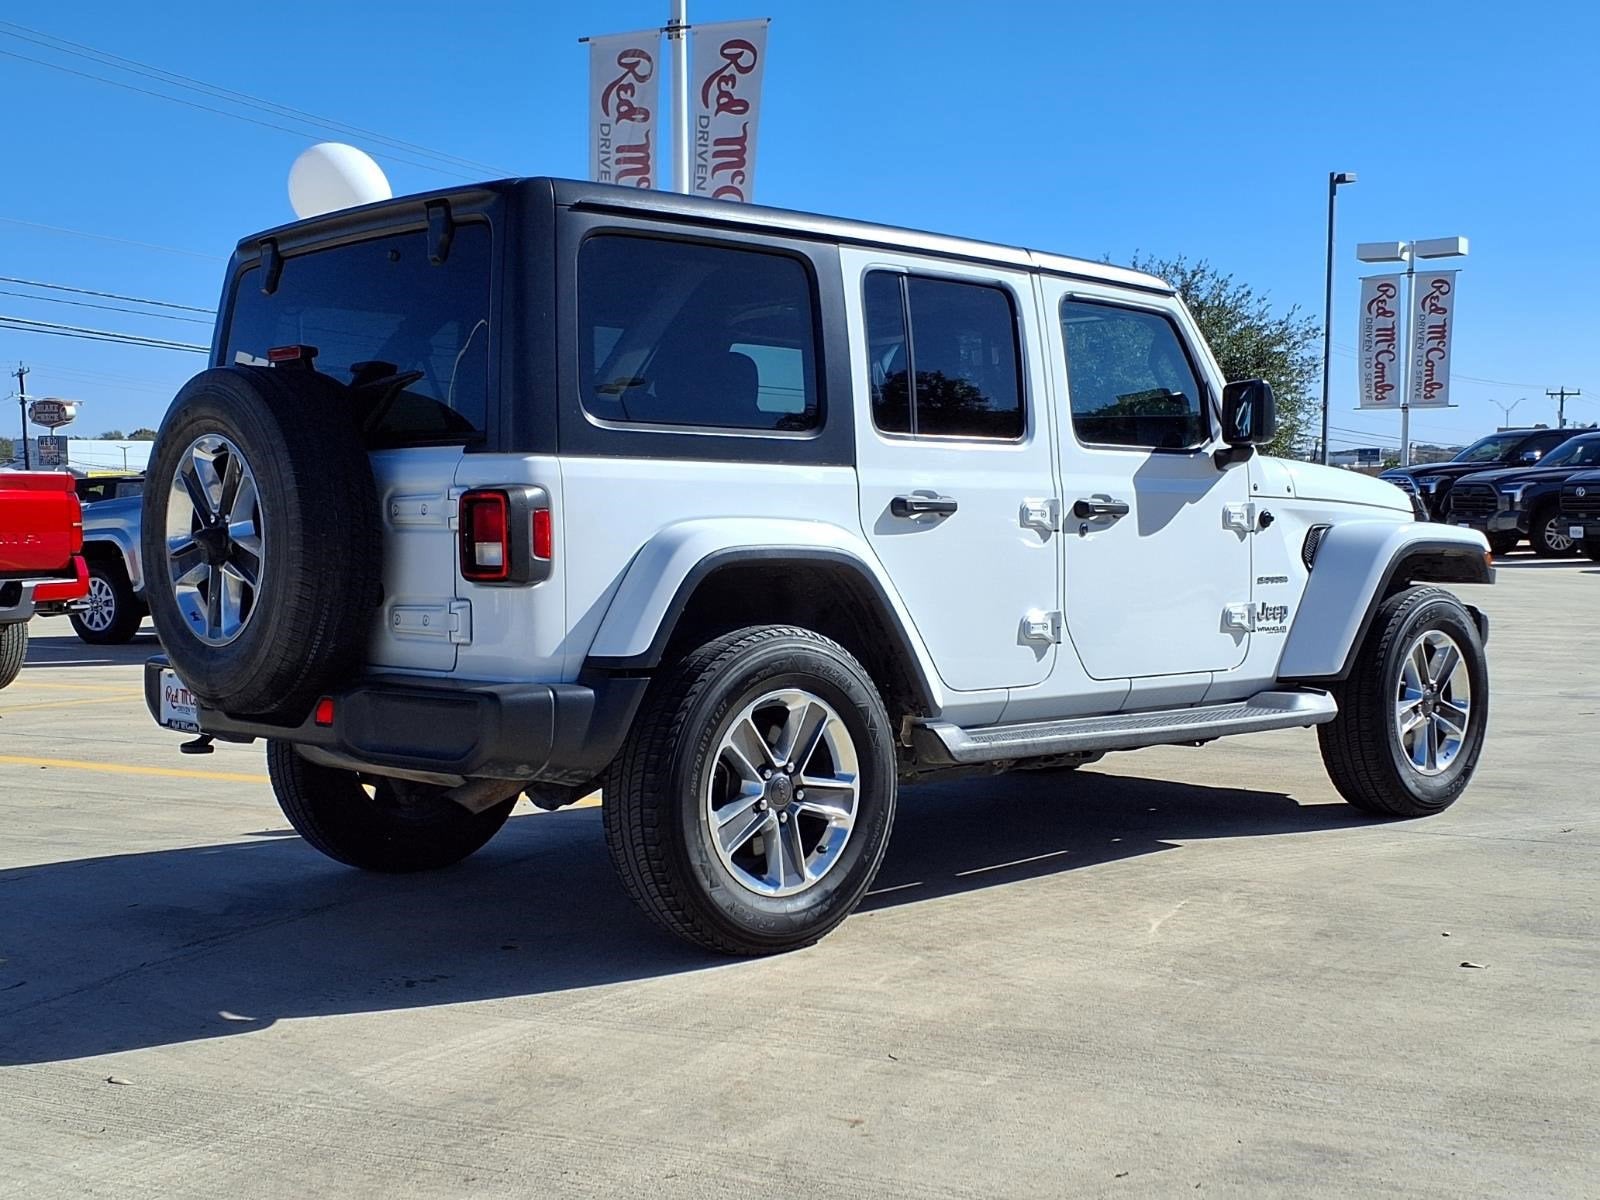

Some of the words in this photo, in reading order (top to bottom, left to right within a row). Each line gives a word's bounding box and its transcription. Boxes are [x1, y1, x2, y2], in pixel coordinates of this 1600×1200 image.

[601, 48, 653, 125] Red
[702, 39, 757, 117] Red
[696, 115, 710, 190] DRIVEN
[1367, 283, 1396, 318] Red
[1421, 279, 1451, 316] Red
[1364, 317, 1373, 352] DRIVEN
[1416, 314, 1425, 350] DRIVEN
[1364, 357, 1372, 369] TO
[1375, 321, 1396, 401] McCombs
[1416, 355, 1424, 367] TO
[1424, 318, 1447, 400] McCombs
[1364, 372, 1373, 400] SERVE
[1415, 369, 1424, 399] SERVE
[1257, 602, 1288, 624] Jeep
